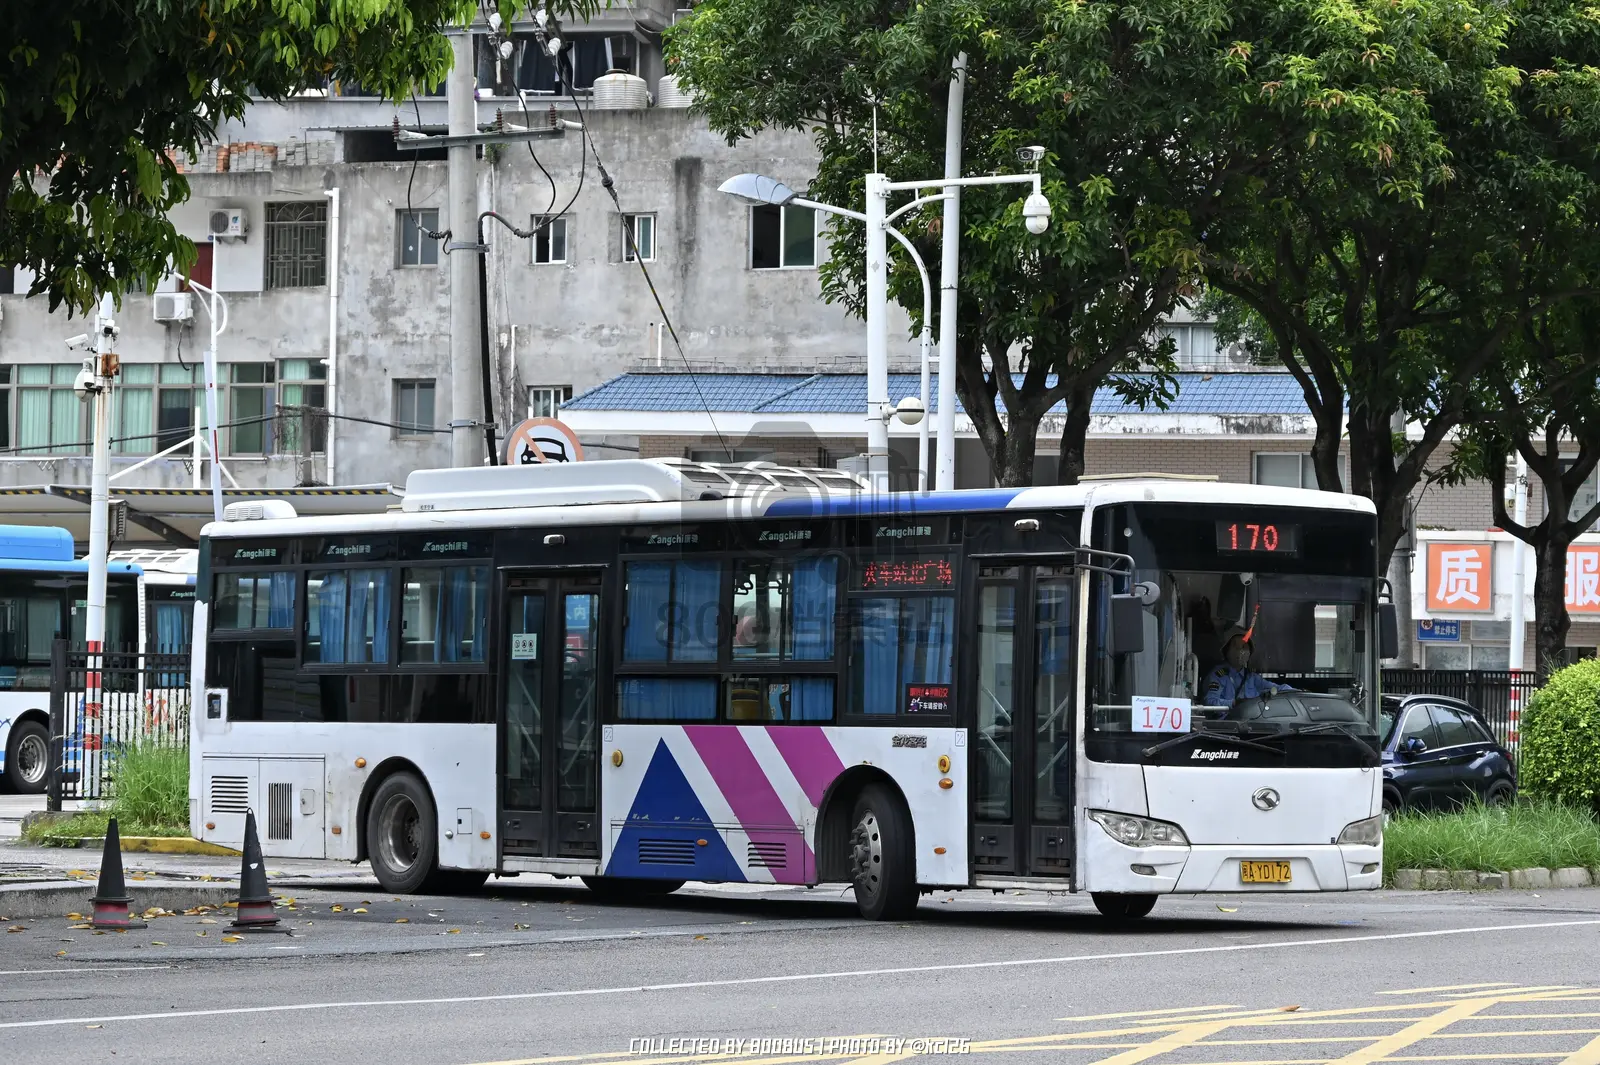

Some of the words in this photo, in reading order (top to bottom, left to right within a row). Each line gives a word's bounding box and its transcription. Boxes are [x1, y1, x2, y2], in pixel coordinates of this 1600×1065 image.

[1228, 524, 1279, 551] 170
[1435, 549, 1482, 605] 质
[1564, 552, 1600, 607] 服
[1142, 706, 1183, 730] 170
